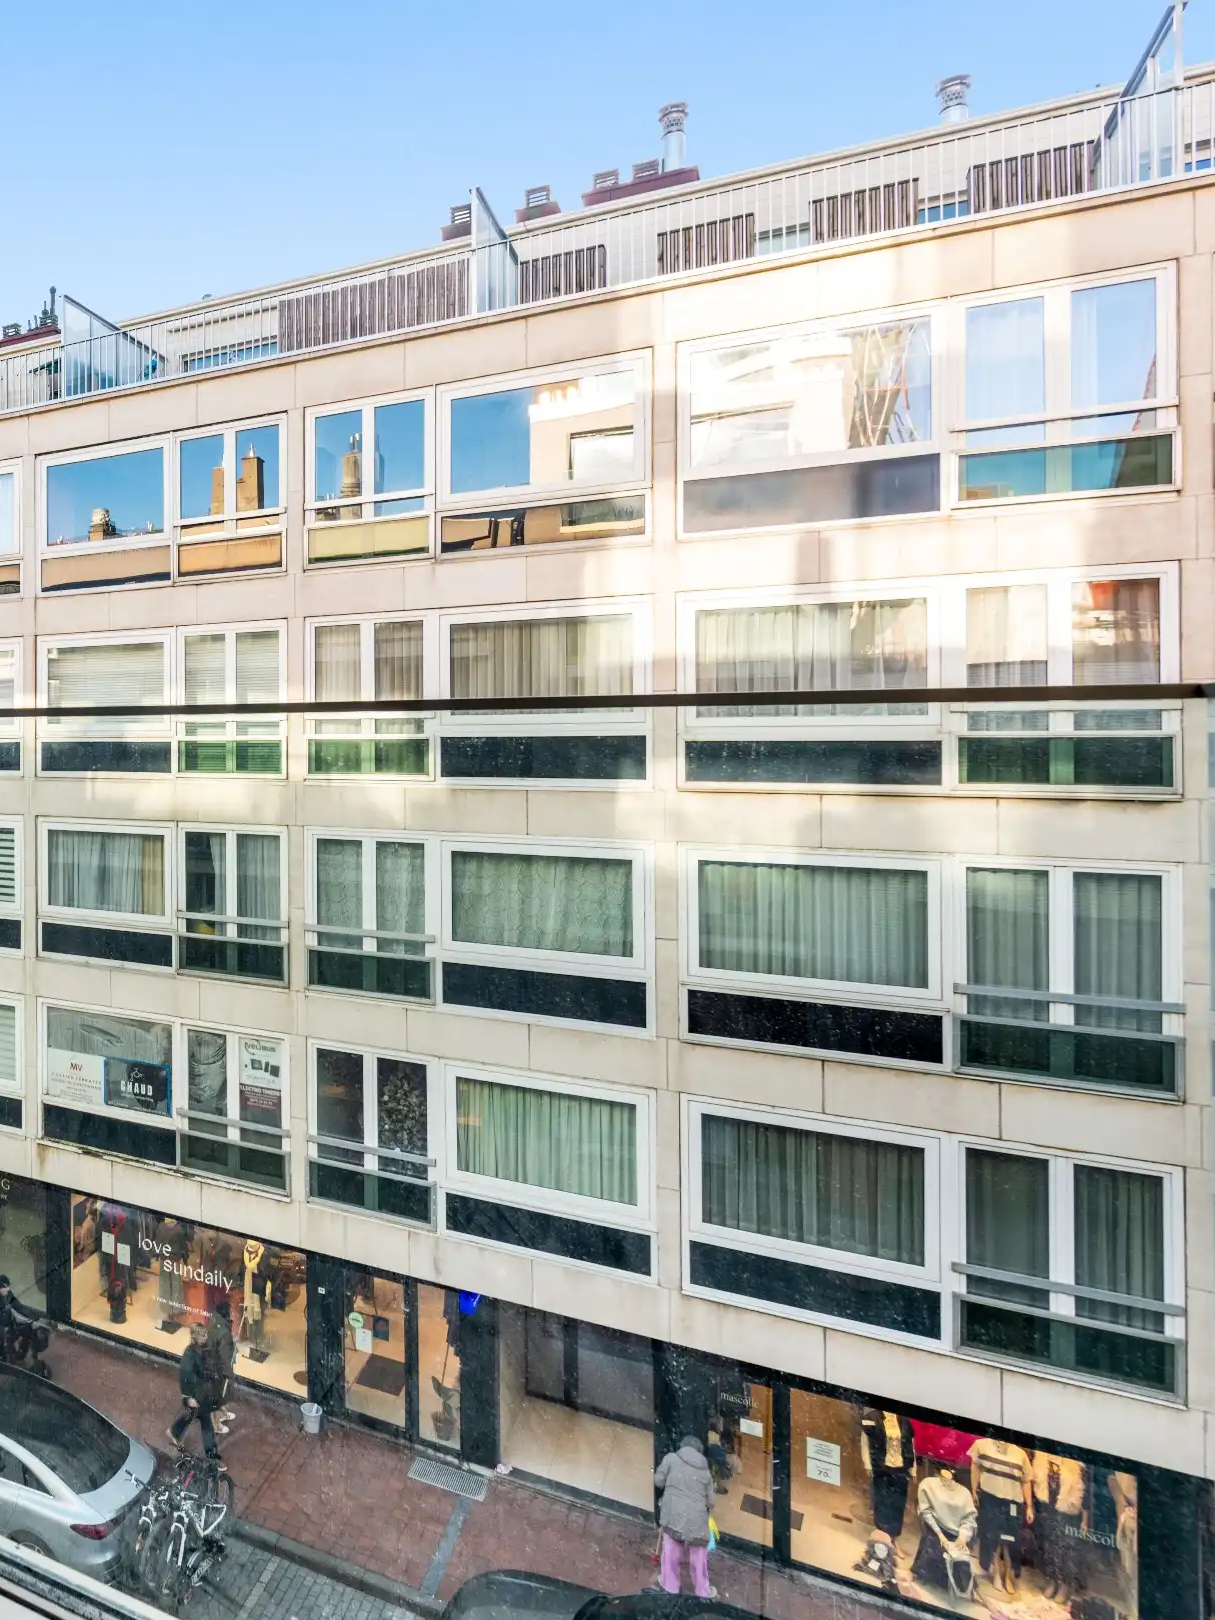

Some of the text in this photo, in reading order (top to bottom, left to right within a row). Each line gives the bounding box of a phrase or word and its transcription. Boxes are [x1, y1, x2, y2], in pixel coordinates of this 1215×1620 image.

[120, 1080, 153, 1096] CHAUD
[138, 1231, 172, 1256] love
[163, 1259, 233, 1293] sundaily
[1065, 1523, 1119, 1548] mascol
